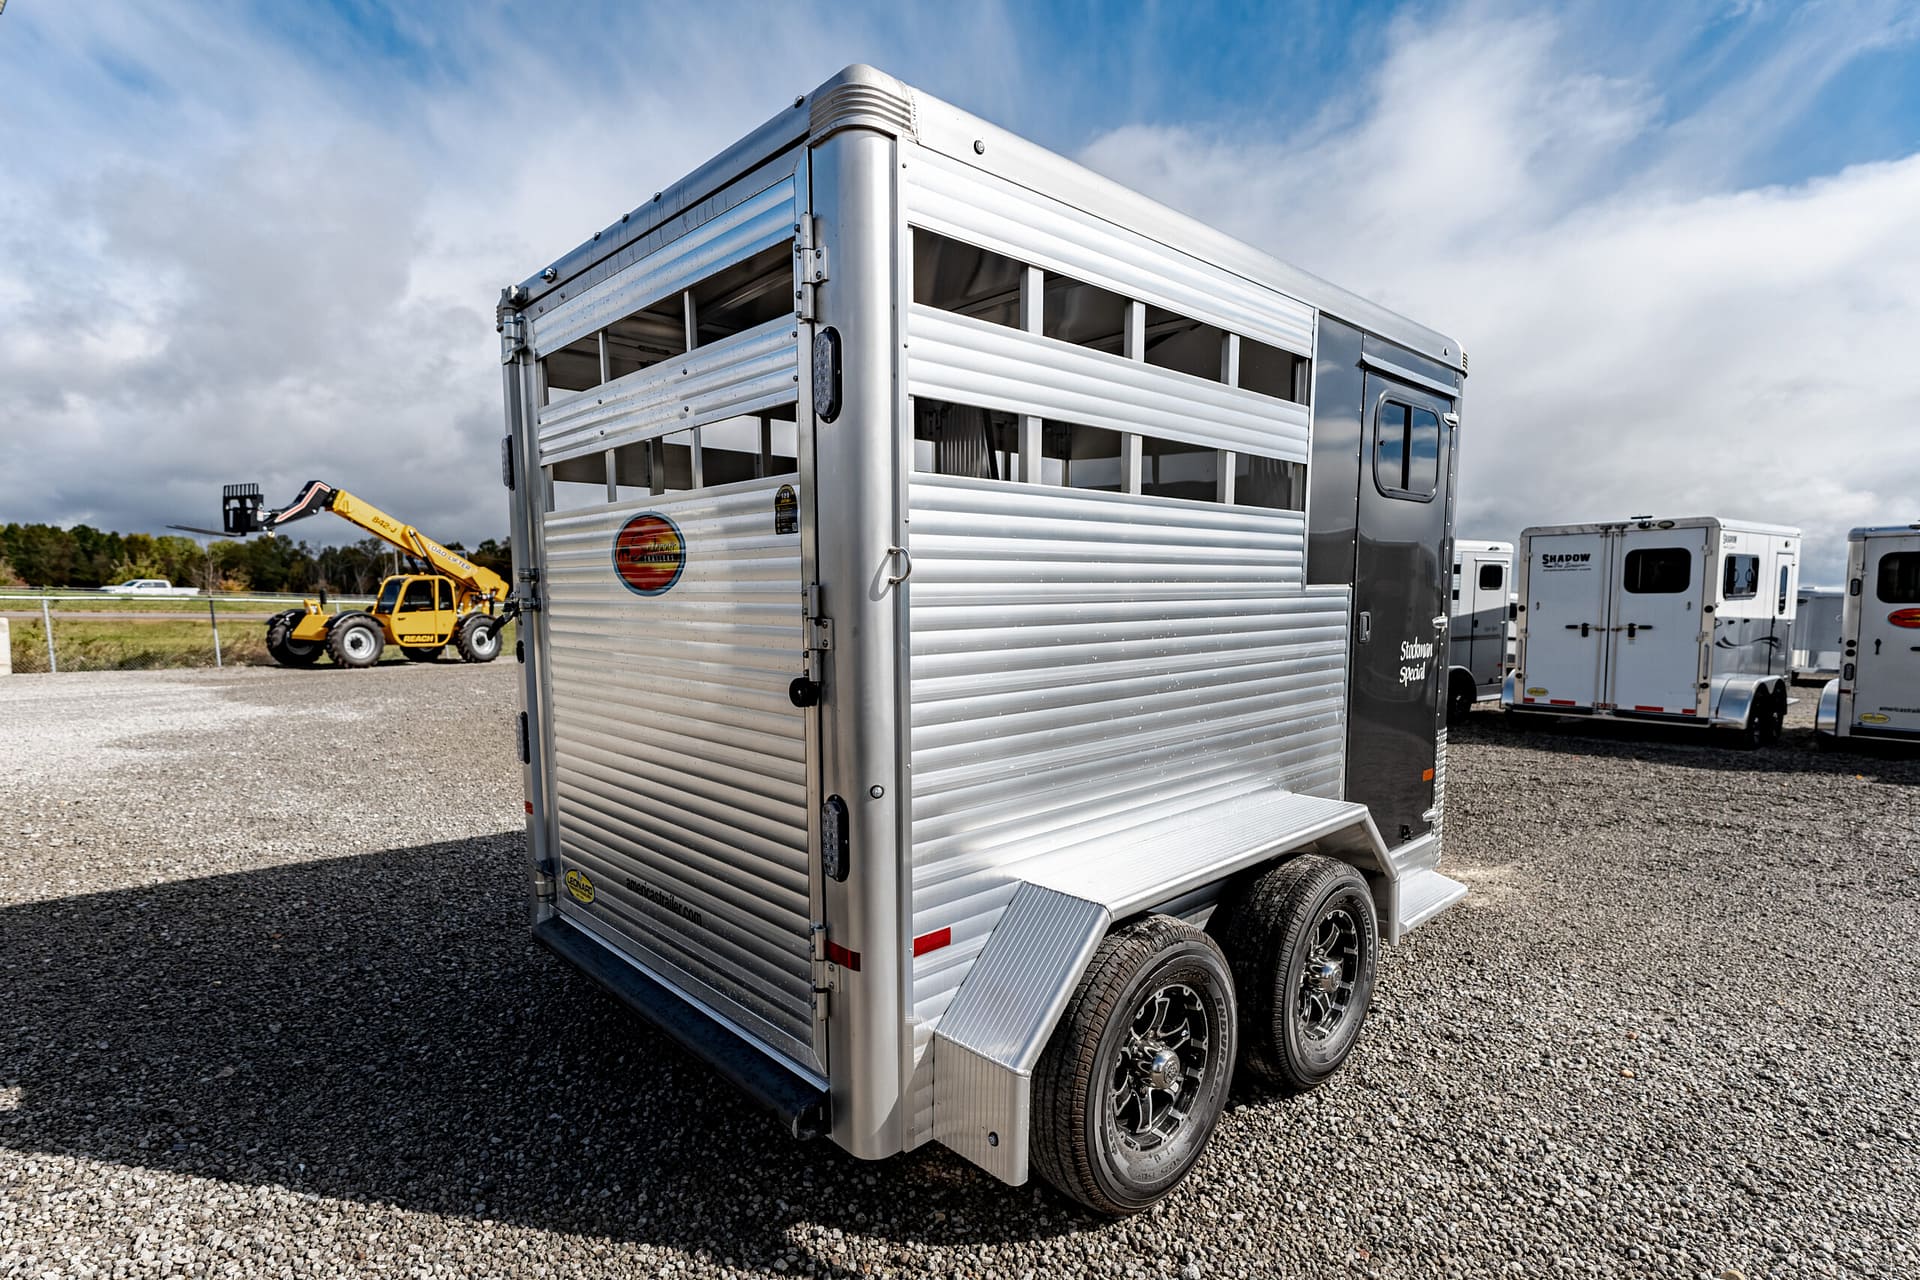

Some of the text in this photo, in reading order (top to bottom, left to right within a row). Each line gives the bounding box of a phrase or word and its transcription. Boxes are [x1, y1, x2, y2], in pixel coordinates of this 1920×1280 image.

[427, 543, 471, 571] LOAD LIFTER
[1542, 553, 1591, 564] SHADOW
[403, 635, 434, 643] REACH
[1399, 661, 1426, 688] Special
[626, 878, 703, 926] americastrailer.com
